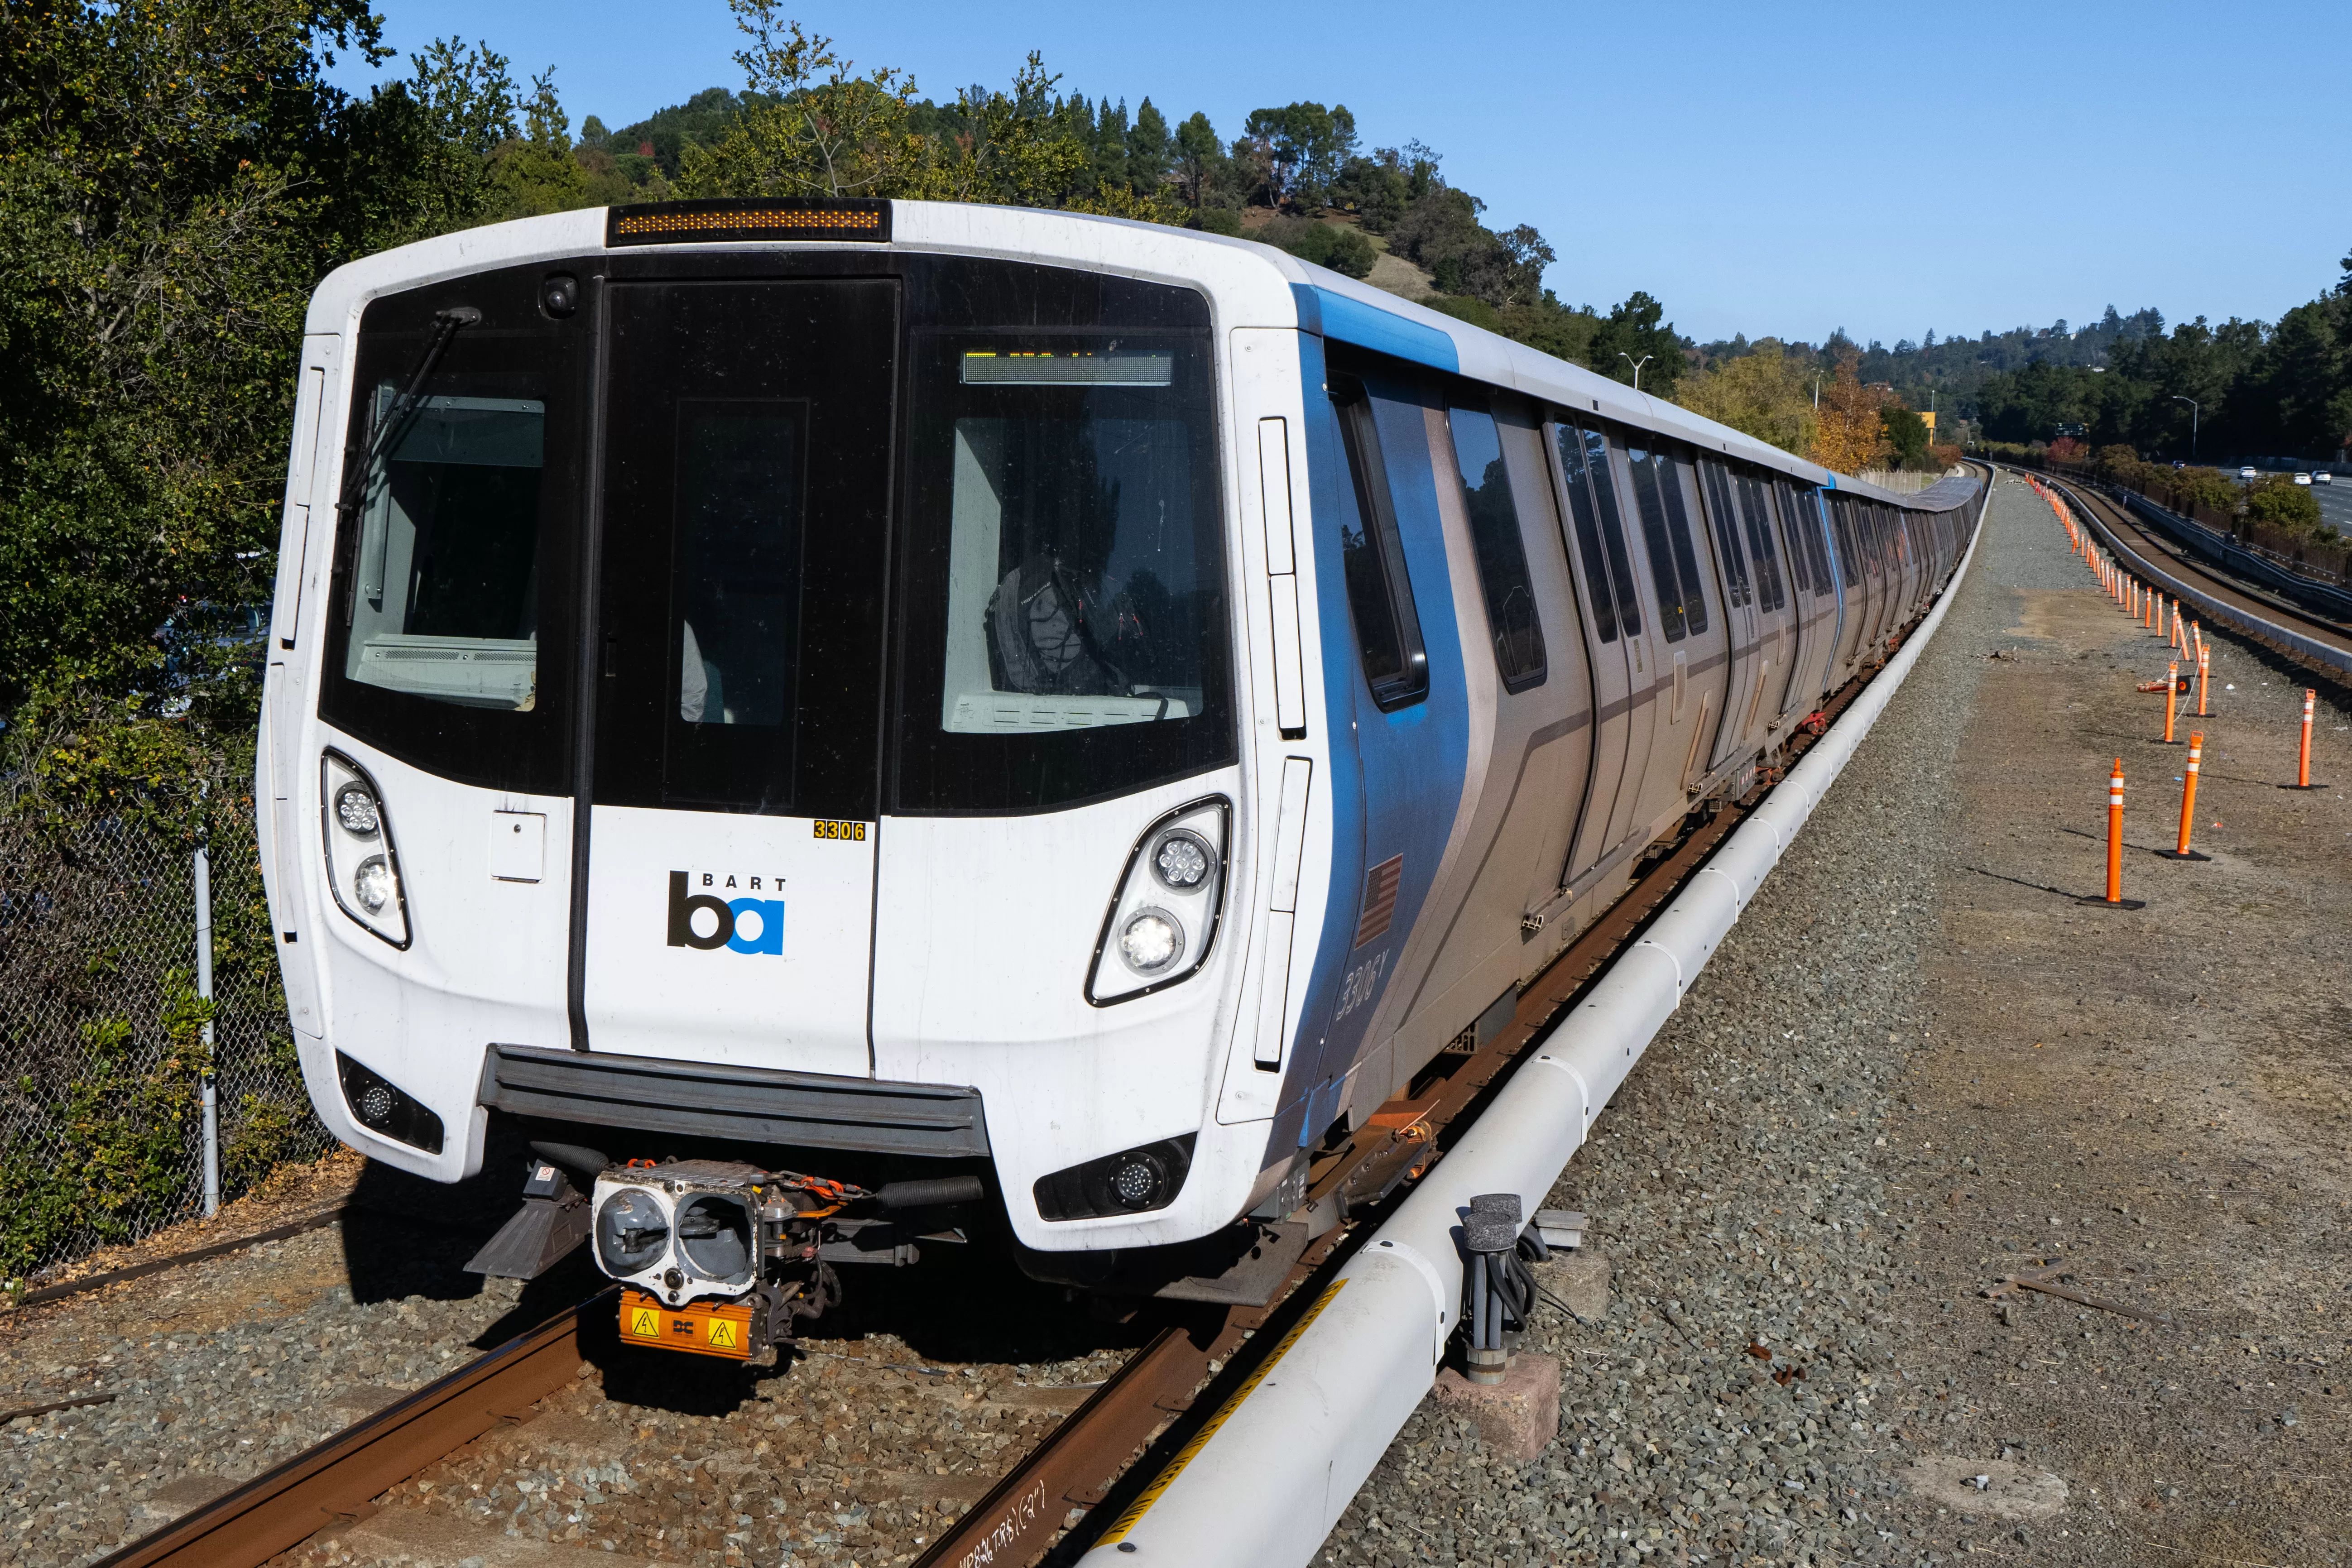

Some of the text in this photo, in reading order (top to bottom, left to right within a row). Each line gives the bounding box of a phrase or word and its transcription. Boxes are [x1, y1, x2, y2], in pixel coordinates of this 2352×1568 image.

[1021, 595, 1033, 605] HIGH
[815, 821, 864, 840] 3306
[703, 873, 786, 892] BART
[667, 870, 785, 954] ba
